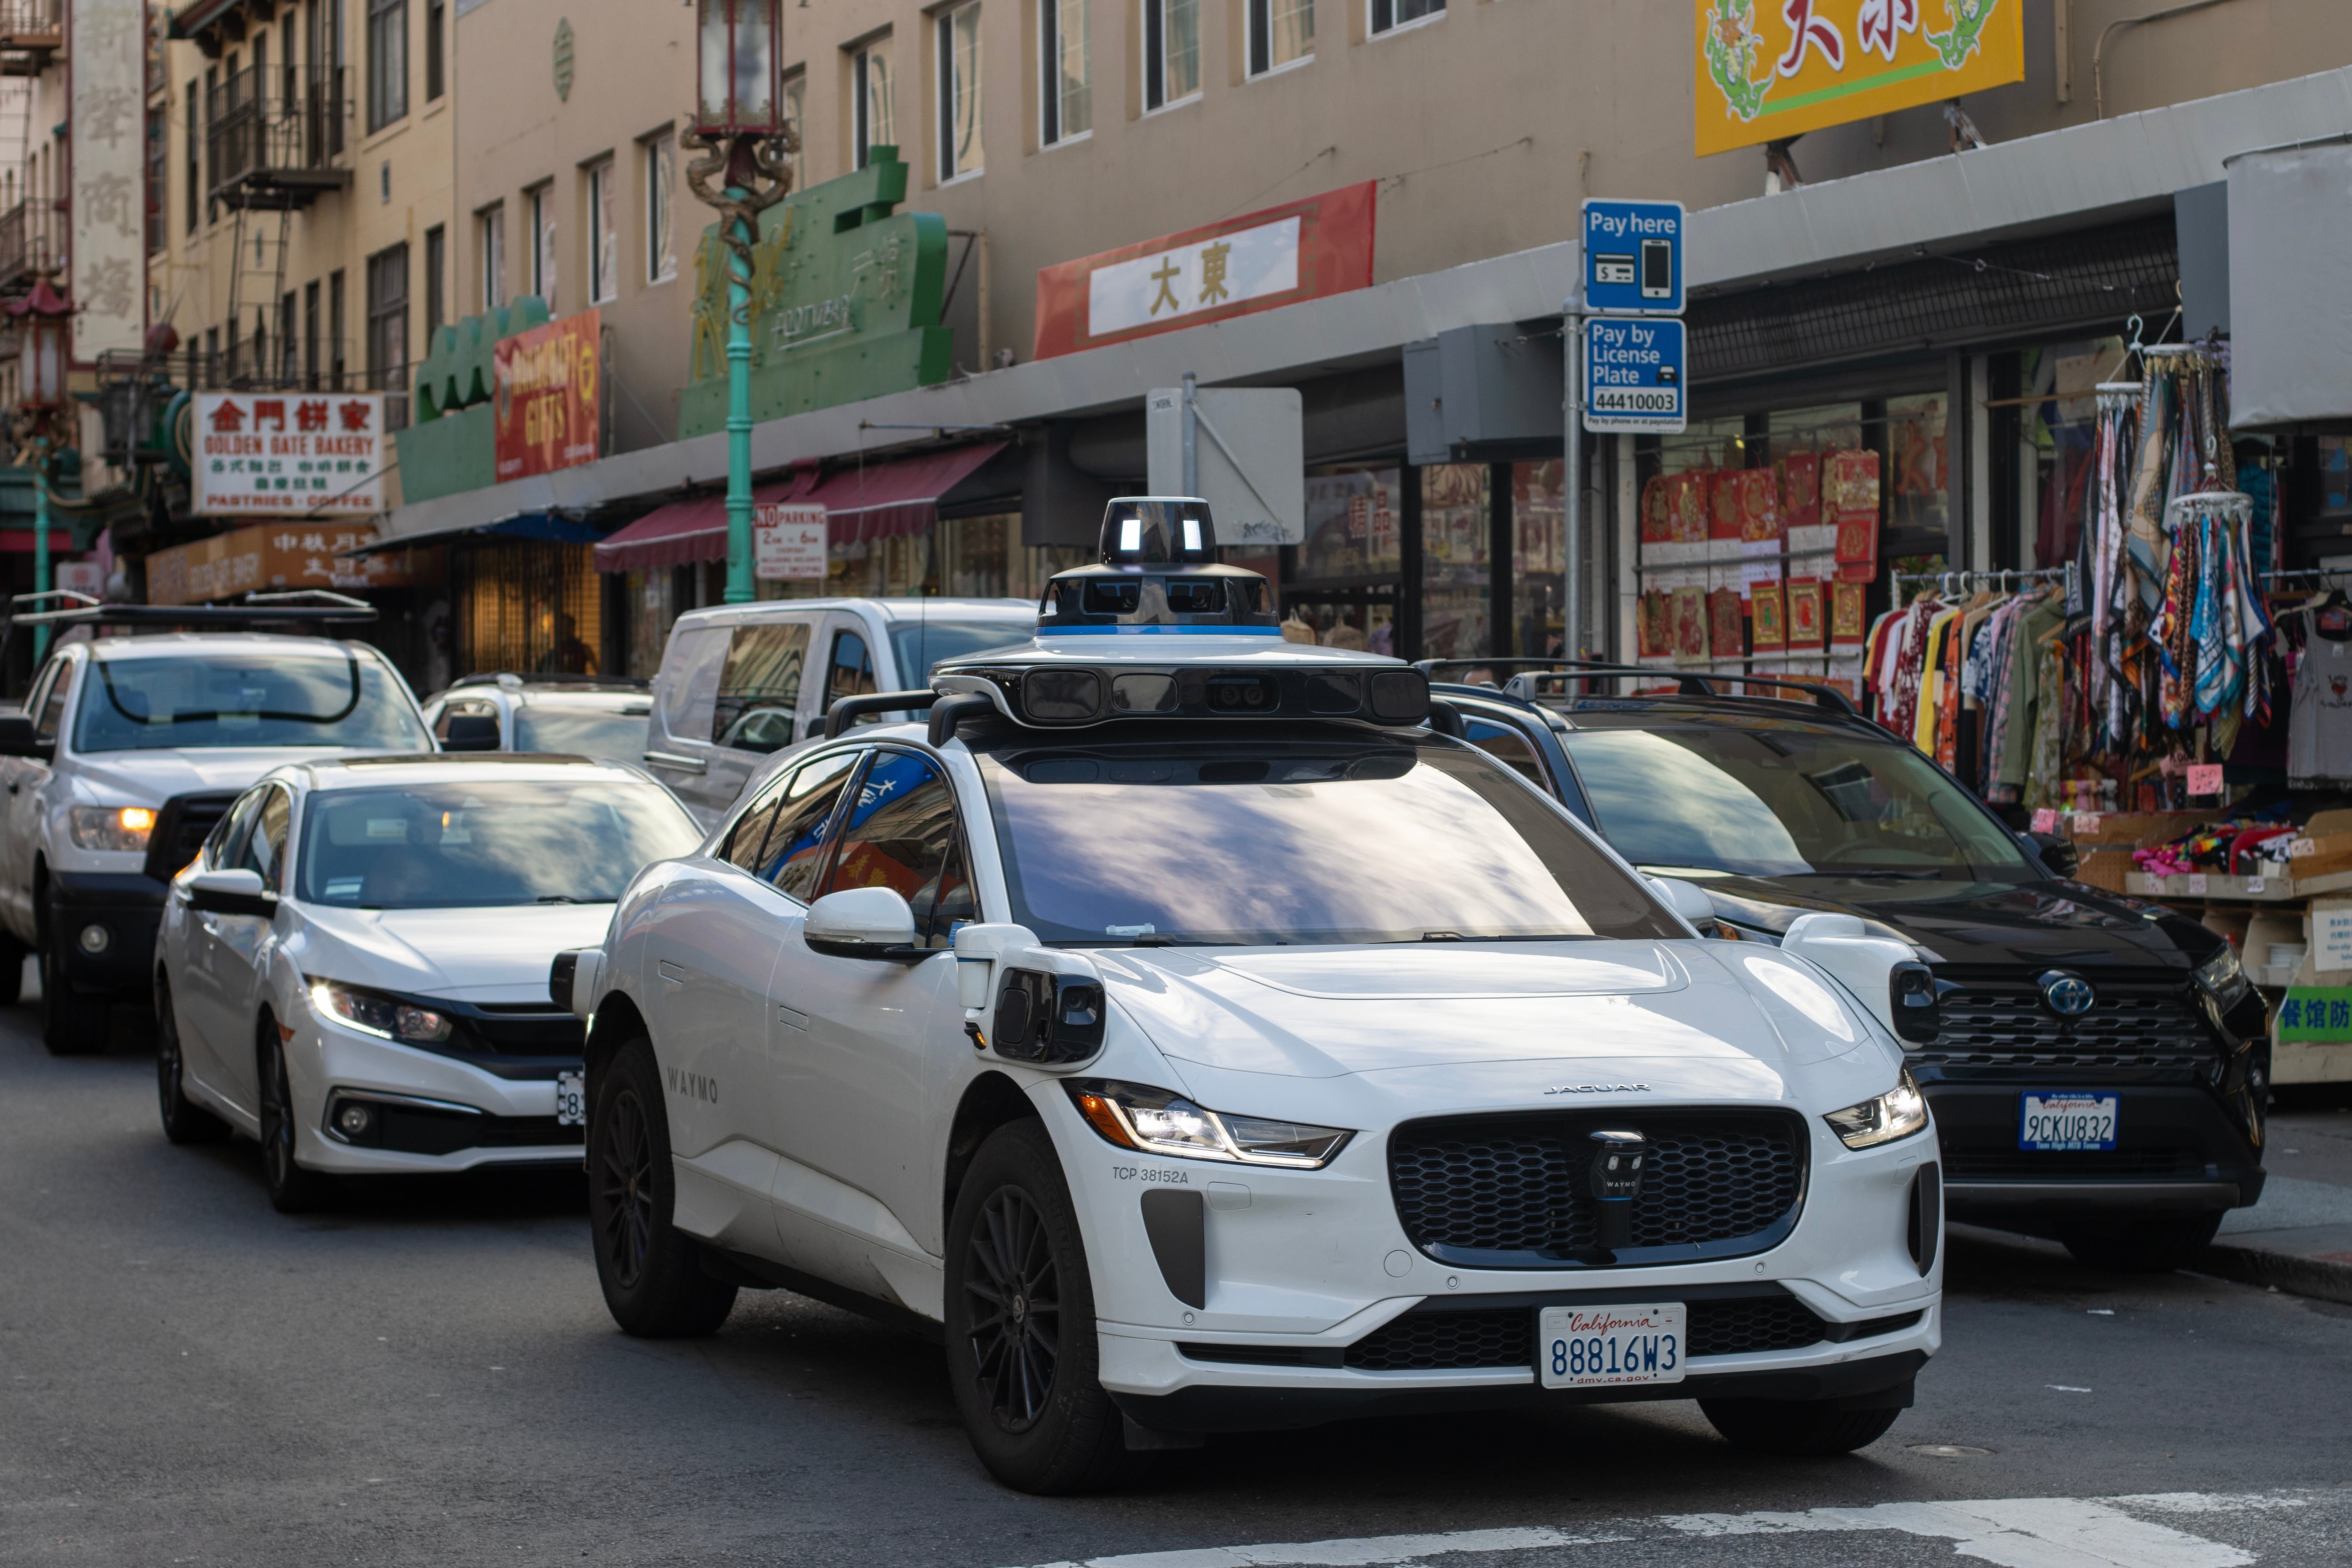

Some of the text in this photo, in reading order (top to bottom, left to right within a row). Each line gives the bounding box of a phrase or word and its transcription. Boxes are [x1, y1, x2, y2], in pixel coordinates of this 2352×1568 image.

[1590, 212, 1677, 237] Pay here
[1149, 241, 1232, 316] 大東
[1593, 324, 1655, 348] Pay by
[1593, 345, 1661, 364] License
[1593, 366, 1640, 384] Plate
[1596, 393, 1675, 410] 44410003
[207, 399, 371, 432] 金門餅家
[525, 391, 564, 447] GIFTS
[205, 435, 373, 455] GOLDEN GATE BAKERY
[207, 494, 373, 507] PASTRIES COFFEE
[756, 507, 825, 526] NO PARKING
[667, 1066, 718, 1105] WAYMO
[1543, 1083, 1652, 1095] JAGUAR
[2042, 1098, 2101, 1113] California
[2028, 1115, 2112, 1141] 9CKU832
[2051, 1141, 2066, 1151] High
[1112, 1166, 1189, 1184] TCP 38152A
[1570, 1312, 1659, 1336] California
[1552, 1334, 1677, 1376] 88816W3
[1577, 1374, 1649, 1384] dmv.ca.gov
